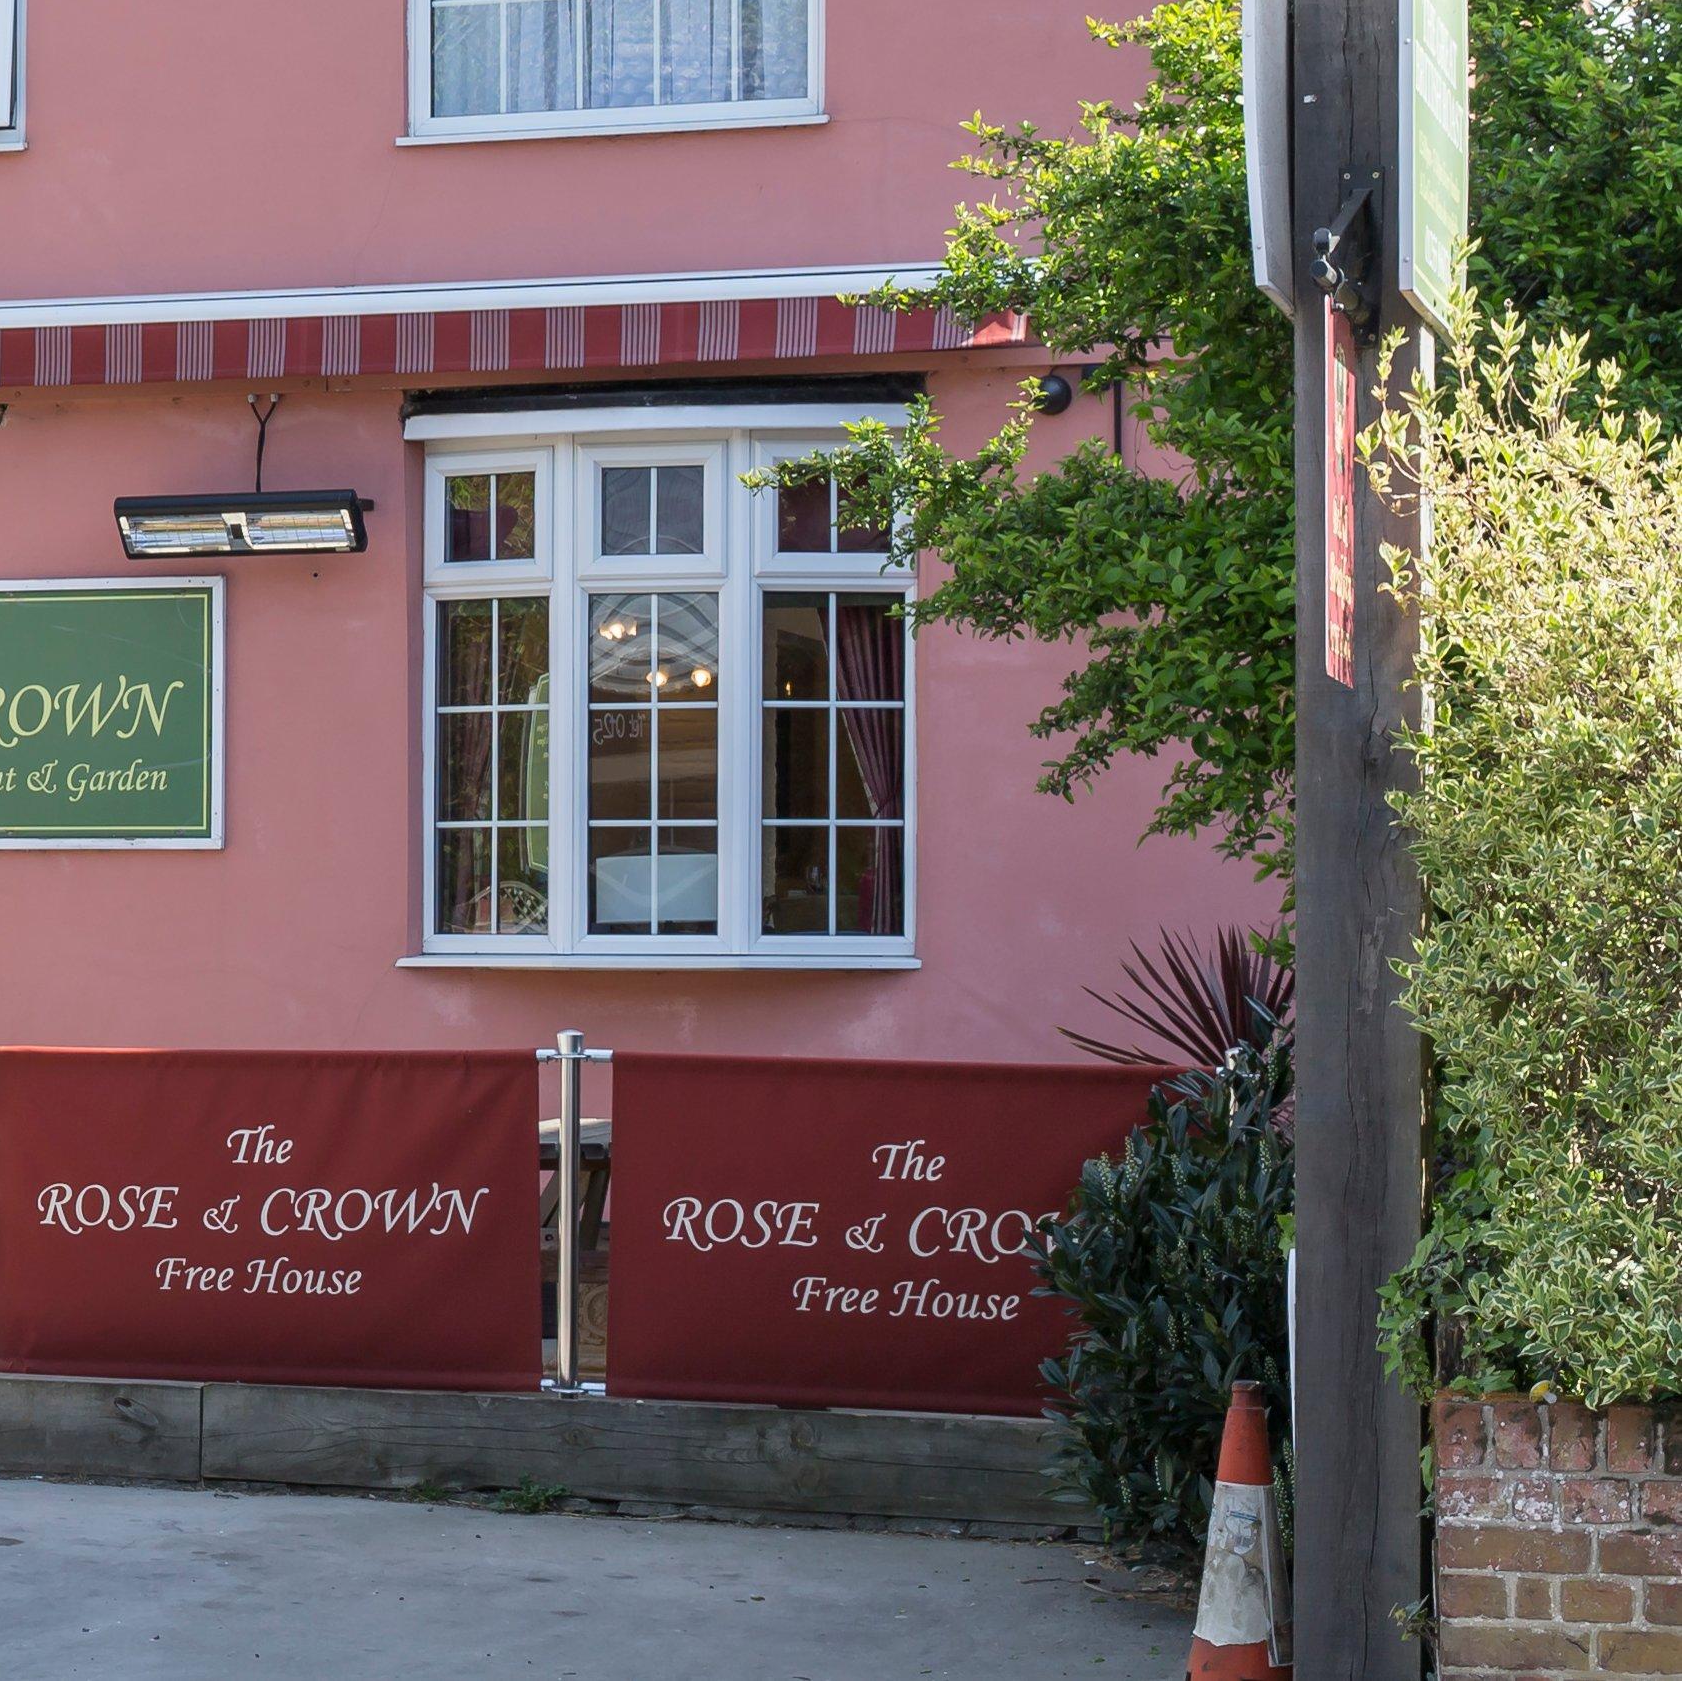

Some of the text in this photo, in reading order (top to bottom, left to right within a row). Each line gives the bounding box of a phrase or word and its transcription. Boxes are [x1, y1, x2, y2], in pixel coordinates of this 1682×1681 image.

[25, 760, 60, 794] &
[65, 760, 169, 803] Garden
[226, 1123, 294, 1164] The
[871, 1138, 946, 1182] The
[37, 1181, 491, 1241] ROSE & CROWN
[662, 1195, 820, 1252] ROSE
[845, 1212, 888, 1254] &
[155, 1255, 363, 1296] Free House
[791, 1276, 1021, 1321] Free House
